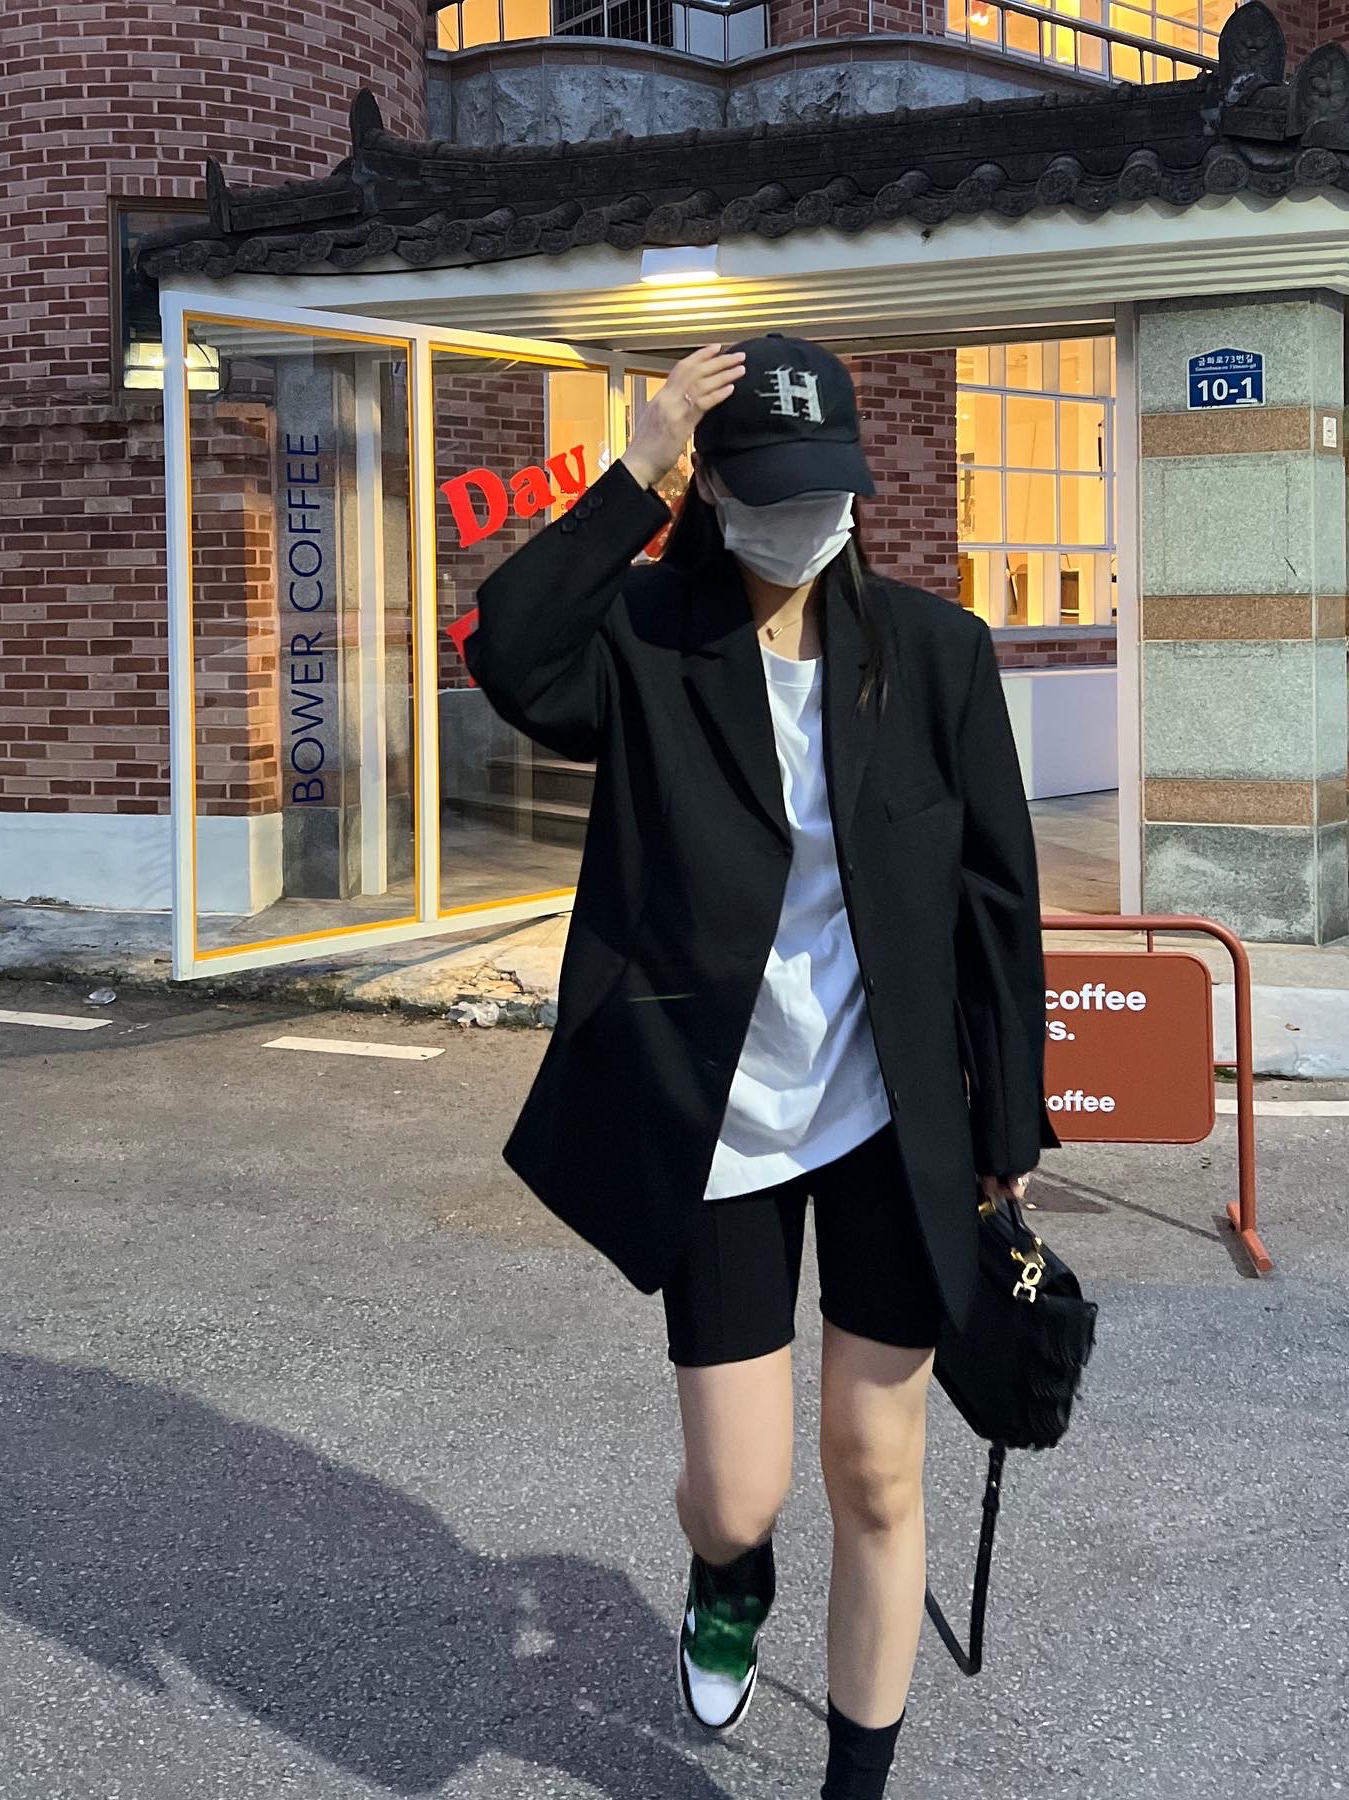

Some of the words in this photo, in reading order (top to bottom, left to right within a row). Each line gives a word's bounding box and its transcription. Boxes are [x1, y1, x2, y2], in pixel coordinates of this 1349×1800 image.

[757, 365, 825, 425] H
[1196, 376, 1253, 402] 10-1
[285, 433, 323, 612] COFFEE
[290, 631, 325, 803] BOWER
[1045, 983, 1147, 1012] coffee
[1045, 1020, 1076, 1041] s.
[1045, 1089, 1116, 1112] offee
